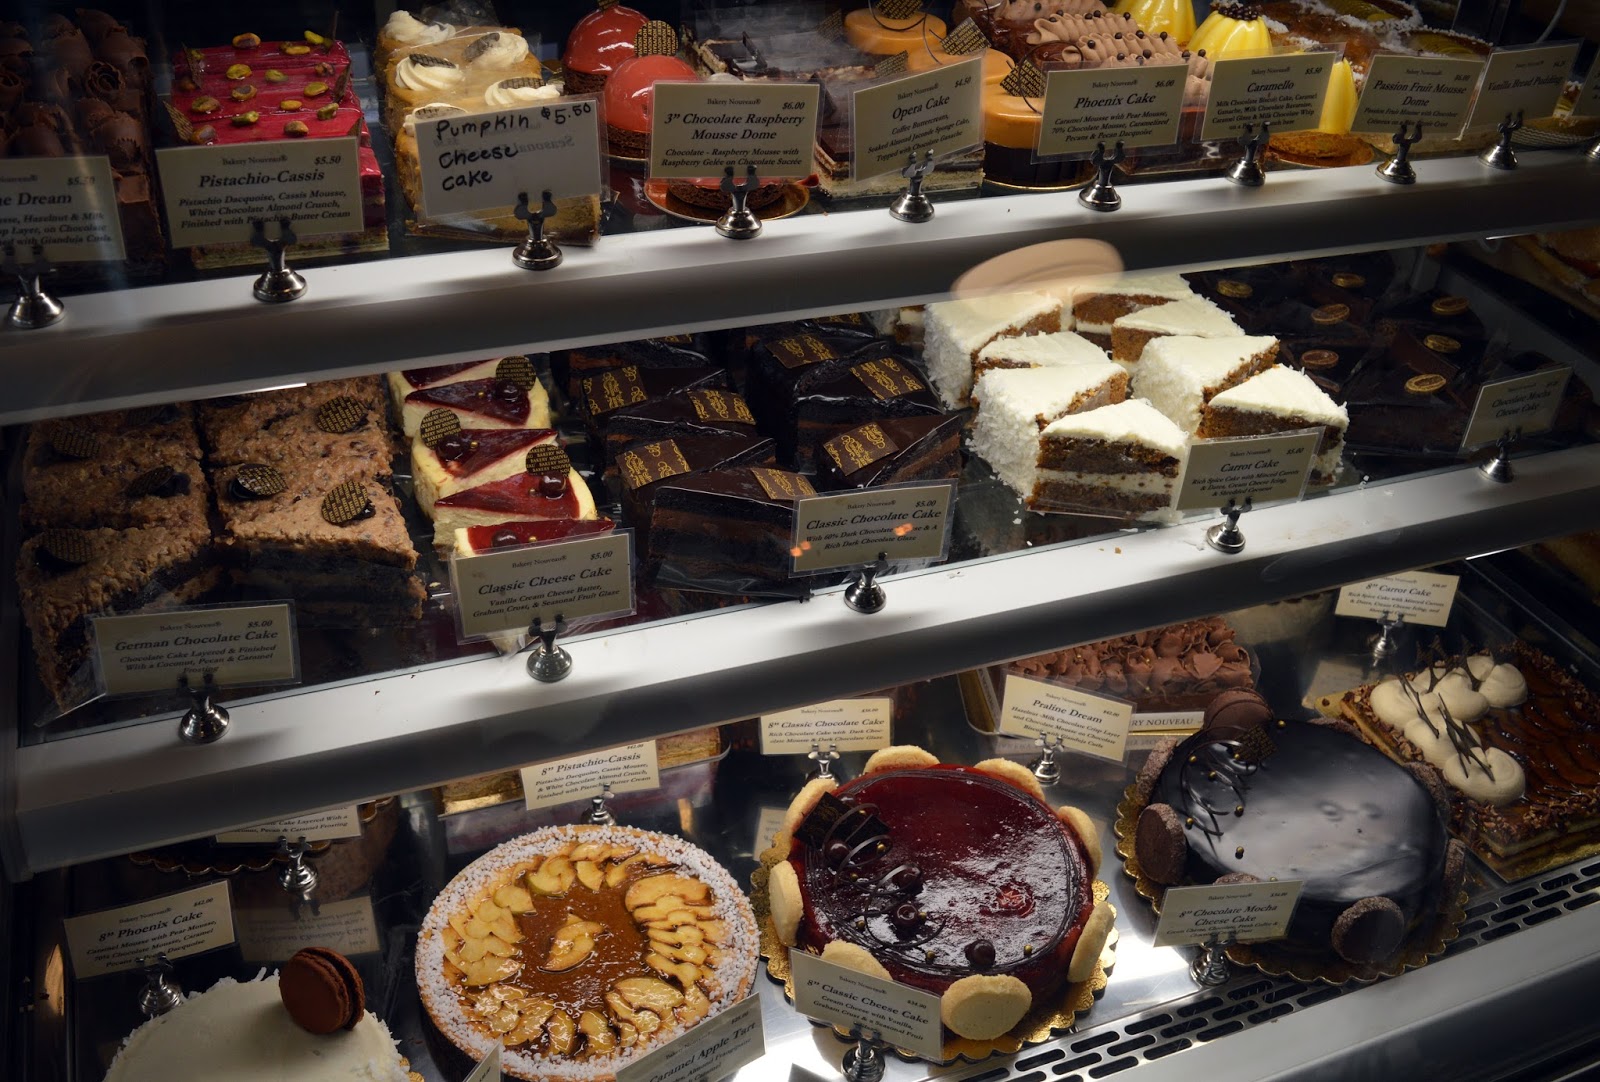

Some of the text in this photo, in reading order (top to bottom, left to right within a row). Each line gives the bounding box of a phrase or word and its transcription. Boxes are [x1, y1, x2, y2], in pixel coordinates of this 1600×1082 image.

[1247, 80, 1294, 92] Caramello
[1074, 92, 1156, 109] Phoenix Cake
[1402, 96, 1430, 106] Dome
[541, 102, 592, 124] $5.50
[892, 96, 950, 121] Opera Cake
[682, 113, 742, 124] Chocolate
[745, 114, 804, 126] Raspberry
[691, 129, 777, 140] Mousse Dome
[712, 149, 749, 157] Raspberry
[314, 155, 341, 165] $5.50
[661, 159, 700, 167] Raspberry
[198, 169, 324, 188] Pistachio-Cassis
[18, 192, 72, 205] Dream
[179, 197, 222, 206] Pistachio
[278, 191, 307, 200] Cassis
[309, 190, 346, 198] Mousse,
[189, 200, 340, 216] White Chocolate Almond Crunch,
[321, 210, 350, 219] Cream
[181, 220, 220, 229] Finished
[1220, 460, 1280, 472] Carrot Cake
[806, 510, 942, 530] Classic Chocolate Cake
[859, 528, 894, 536] Chocolate
[860, 537, 895, 545] Chocolate
[590, 551, 612, 560] $5.00
[478, 567, 612, 595] Classic Cheese Cake
[1380, 584, 1408, 594] Carrot
[1409, 588, 1431, 596] Cake
[473, 608, 505, 618] Graham
[507, 604, 530, 613] Crust,
[542, 596, 576, 606] Seasonal
[577, 592, 597, 600] Fruit
[490, 596, 516, 608] Vanilla
[520, 593, 545, 602] Cream
[547, 590, 574, 598] Cheese
[248, 620, 273, 628] $5.00
[114, 630, 278, 651] German Chocolate Cake
[119, 654, 164, 664] Chocolate
[166, 652, 189, 660] Cake
[191, 648, 226, 658] Layered
[238, 644, 276, 653] Finished
[237, 653, 274, 662] Caramel
[1032, 699, 1102, 724] Praline Dream
[556, 752, 641, 773] Pistachio-Cassis
[1193, 908, 1241, 918] Chocolate
[1243, 904, 1278, 913] Mocha
[118, 920, 169, 938] Phoenix
[172, 911, 203, 926] Cake
[1194, 916, 1256, 926] Cheese Cake
[813, 1000, 840, 1013] Graham
[822, 984, 858, 1000] Classic
[861, 997, 899, 1014] Cheese
[902, 1010, 929, 1024] Cake
[822, 996, 844, 1006] Cream
[872, 1012, 886, 1020] with
[650, 1022, 756, 1082] Caramel Apple Tart
